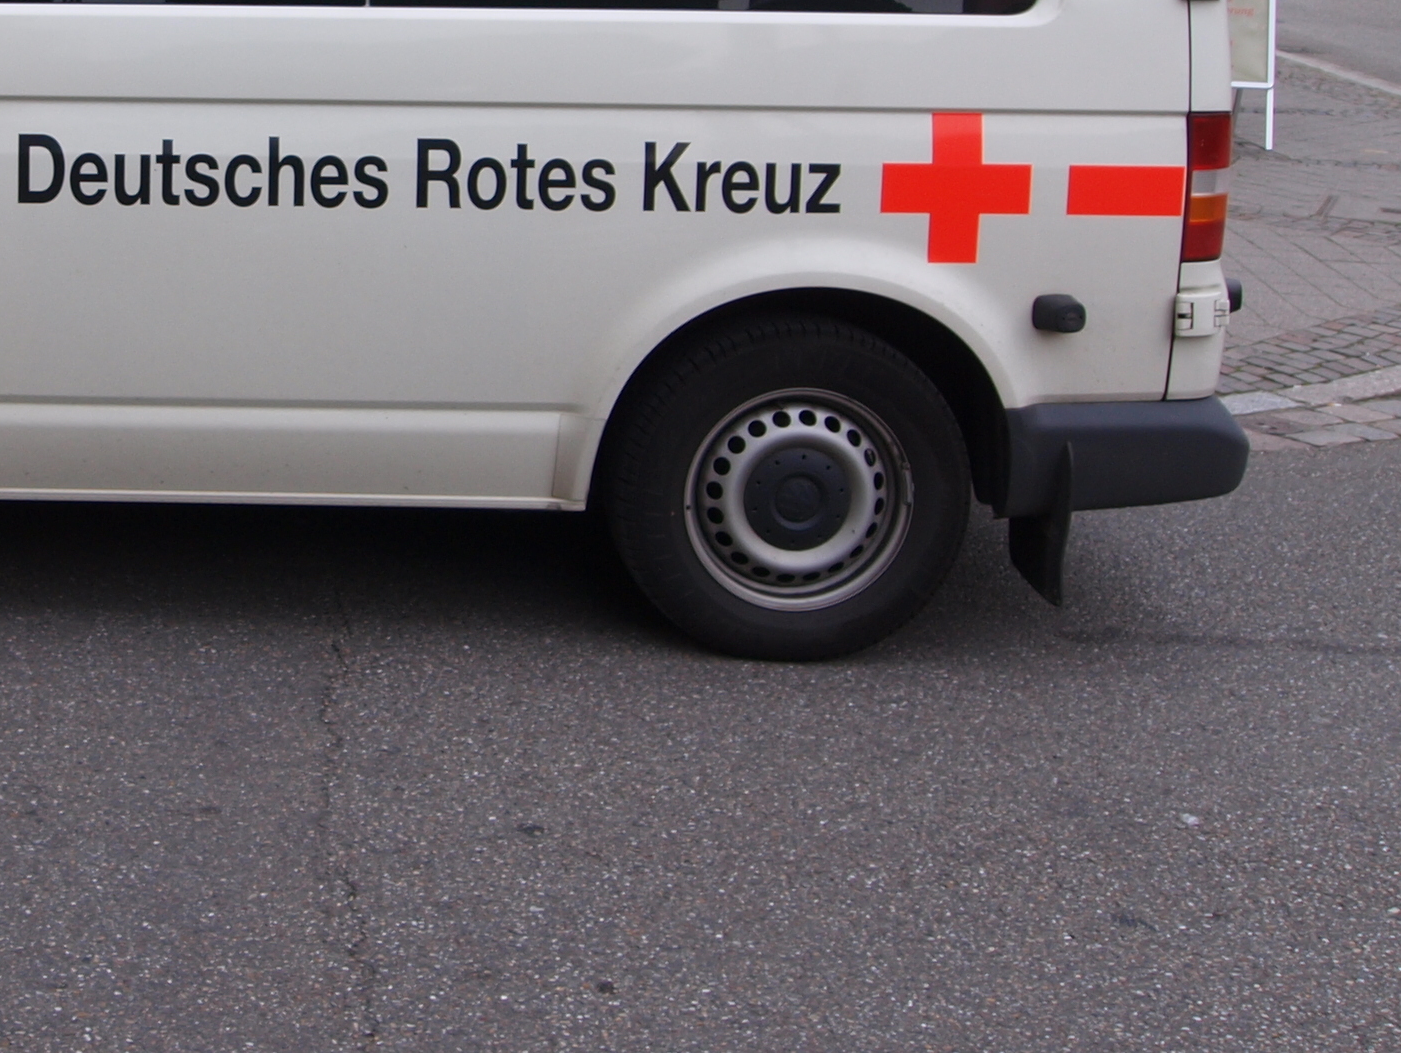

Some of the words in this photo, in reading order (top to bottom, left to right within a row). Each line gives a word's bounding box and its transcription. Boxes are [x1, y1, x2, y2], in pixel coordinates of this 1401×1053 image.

[17, 133, 389, 208] Deutsches
[415, 138, 616, 211] Rotes
[643, 141, 841, 215] Kreuz
